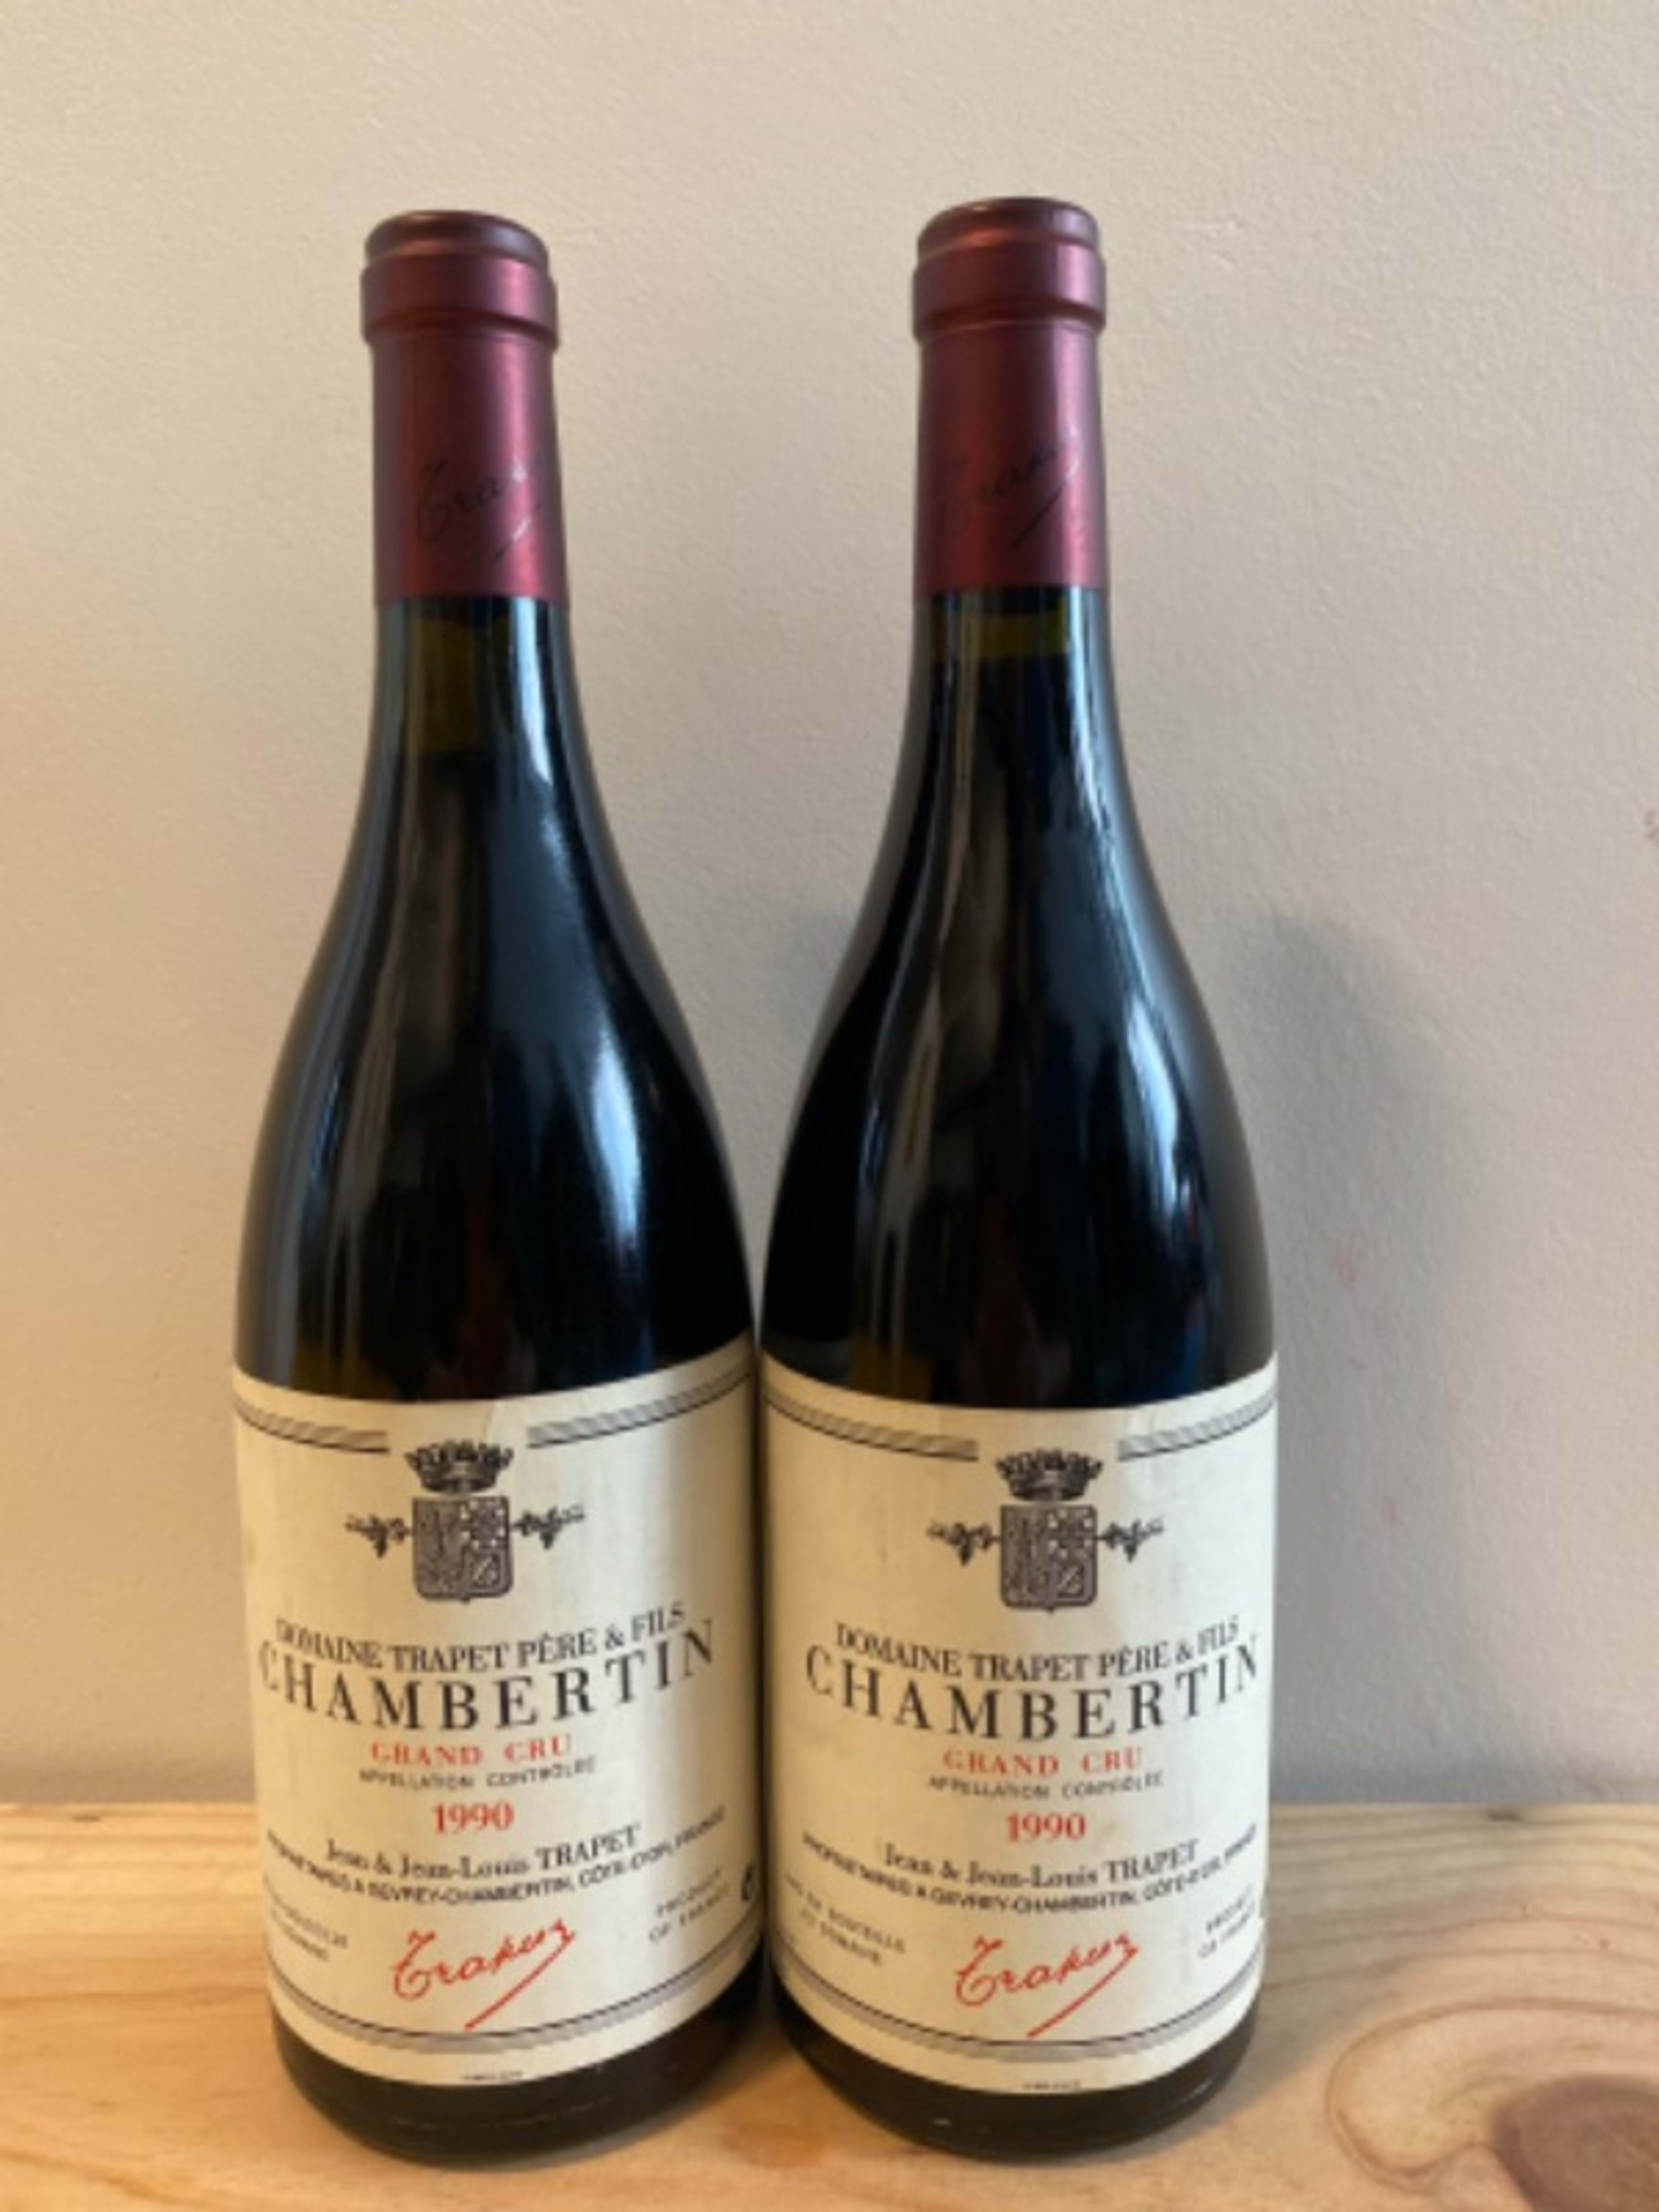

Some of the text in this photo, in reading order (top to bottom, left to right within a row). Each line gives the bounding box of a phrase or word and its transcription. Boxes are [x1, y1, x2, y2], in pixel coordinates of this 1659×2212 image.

[277, 1601, 686, 1673] DOMAINE TRAPET PÈRE & FILS
[836, 1615, 1239, 1683] DOMAINE TRAPET PÈRE & FILS
[261, 1618, 713, 1730] CHAMBERTIN
[806, 1633, 1259, 1741] CHAMBERTIN
[371, 1734, 572, 1767] GRAND CRU
[944, 1747, 1143, 1776] GRAND CRU
[928, 1775, 1050, 1800] APPELLATION
[432, 1801, 514, 1834] 1990
[1007, 1813, 1086, 1843] 1990
[328, 1822, 640, 1879] Jean & Jean-Louis TRAPET
[885, 1838, 1199, 1889] Jean & Jean-Louis TRAPET
